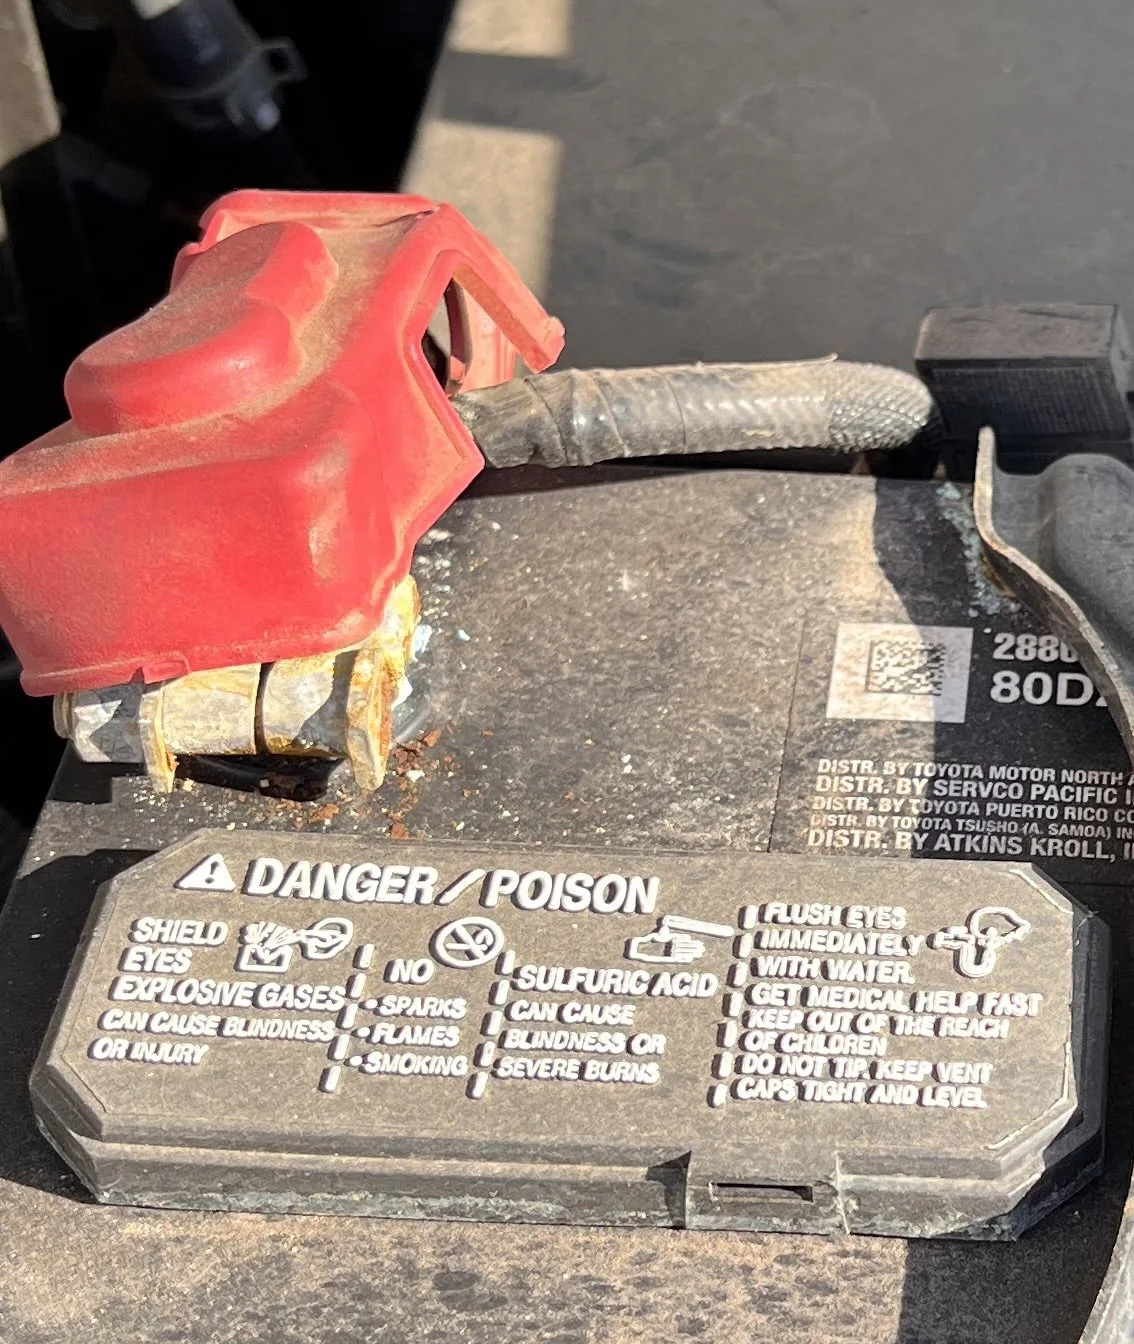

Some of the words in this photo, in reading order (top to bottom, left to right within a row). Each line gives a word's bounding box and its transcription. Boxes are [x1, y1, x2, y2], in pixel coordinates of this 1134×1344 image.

[990, 670, 1108, 707] 80D
[816, 758, 878, 775] DISTR.
[883, 759, 912, 776] BY
[913, 761, 984, 779] TOYOTA
[988, 765, 1056, 782] MOTOR
[1061, 768, 1124, 787] NORTH
[815, 774, 890, 795] DISTR.
[896, 776, 927, 796] BY
[932, 778, 1024, 801] SERVCO
[1030, 783, 1118, 805] PACIFIC
[811, 796, 875, 813] DISTR.
[880, 798, 905, 814] BY
[908, 799, 981, 817] TOYOTA
[985, 802, 1059, 820] PUERTO
[1064, 806, 1109, 822] RICO
[865, 815, 886, 830] BY
[891, 816, 953, 832] TOYOTA
[956, 818, 1019, 836] TSUSHO
[1048, 823, 1112, 841] SAMOA)
[807, 828, 889, 850] DISTR.
[894, 830, 930, 852] BY
[933, 832, 1024, 856] ATKINS
[1029, 837, 1117, 863] KROLL,
[243, 857, 438, 905] DANGER
[481, 869, 661, 915] POISON
[760, 902, 843, 927] FLUSH
[844, 905, 908, 930] EYES
[131, 916, 229, 947] SHIELD
[755, 928, 926, 957] IMMEDIATELY
[120, 945, 193, 975] EYES
[385, 958, 437, 985] NO
[751, 955, 822, 980] WITH
[822, 958, 917, 985] WATER.
[111, 975, 256, 1008] EXPLOSIVE
[255, 982, 348, 1012] GASES
[510, 965, 651, 997] SULFURIC
[650, 971, 720, 1000] ACID
[376, 994, 468, 1020] SPARKS
[507, 999, 560, 1023] CAN
[560, 1002, 637, 1026] CAUSE
[746, 981, 802, 1006] GET
[803, 985, 910, 1013] MEDICAL
[911, 990, 978, 1015] HELP
[980, 992, 1043, 1017] FAST
[101, 1008, 150, 1033] CAN
[150, 1011, 221, 1037] CAUSE
[221, 1016, 337, 1043] BLINDNESS
[372, 1022, 461, 1048] FLAMES
[743, 1009, 804, 1031] KEEP
[804, 1010, 854, 1033] OUT
[854, 1013, 890, 1035] OF
[891, 1015, 936, 1037] THE
[936, 1017, 1010, 1039] REACH
[91, 1037, 131, 1061] OR
[131, 1040, 210, 1066] INJURY
[501, 1028, 627, 1055] BLINDNESS
[628, 1032, 667, 1056] OR
[739, 1030, 778, 1053] OF
[777, 1033, 888, 1057] CHILDREN
[359, 1051, 469, 1078] SMOKING
[493, 1056, 581, 1082] SEVERE
[583, 1061, 661, 1086] BURNS
[736, 1053, 777, 1076] DO
[777, 1055, 829, 1077] NOT
[871, 1060, 933, 1083] KEEP
[934, 1063, 994, 1086] VENT
[731, 1077, 797, 1102] CAPS
[799, 1079, 868, 1104] TIGHT
[866, 1084, 920, 1107] AND
[919, 1086, 988, 1109] LEVEL
